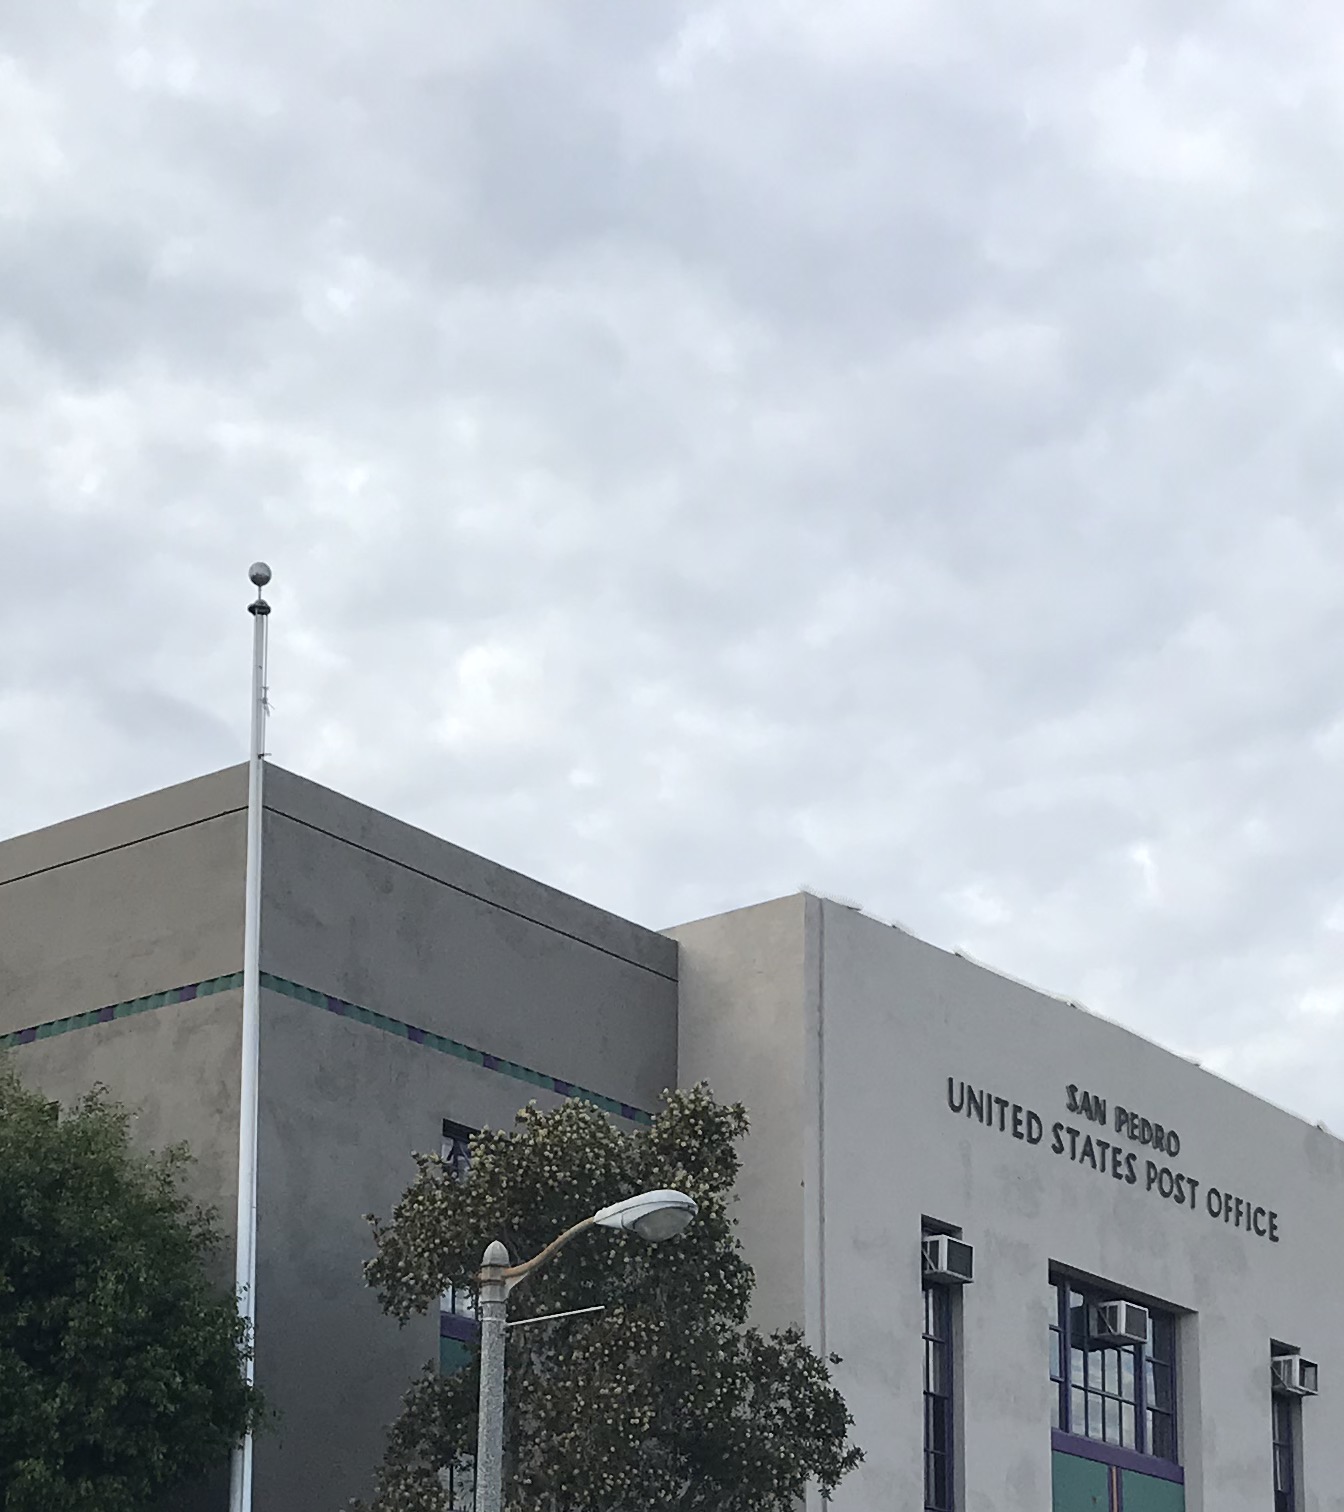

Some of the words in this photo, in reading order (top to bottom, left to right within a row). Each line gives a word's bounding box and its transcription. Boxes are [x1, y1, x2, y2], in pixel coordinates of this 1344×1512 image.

[947, 1076, 1043, 1146] UNITED
[1051, 1121, 1137, 1185] STATES
[1146, 1159, 1199, 1210] POST
[1207, 1187, 1280, 1243] OFFICE
[1066, 1083, 1106, 1126] SAN
[1114, 1105, 1180, 1158] PEDRO
